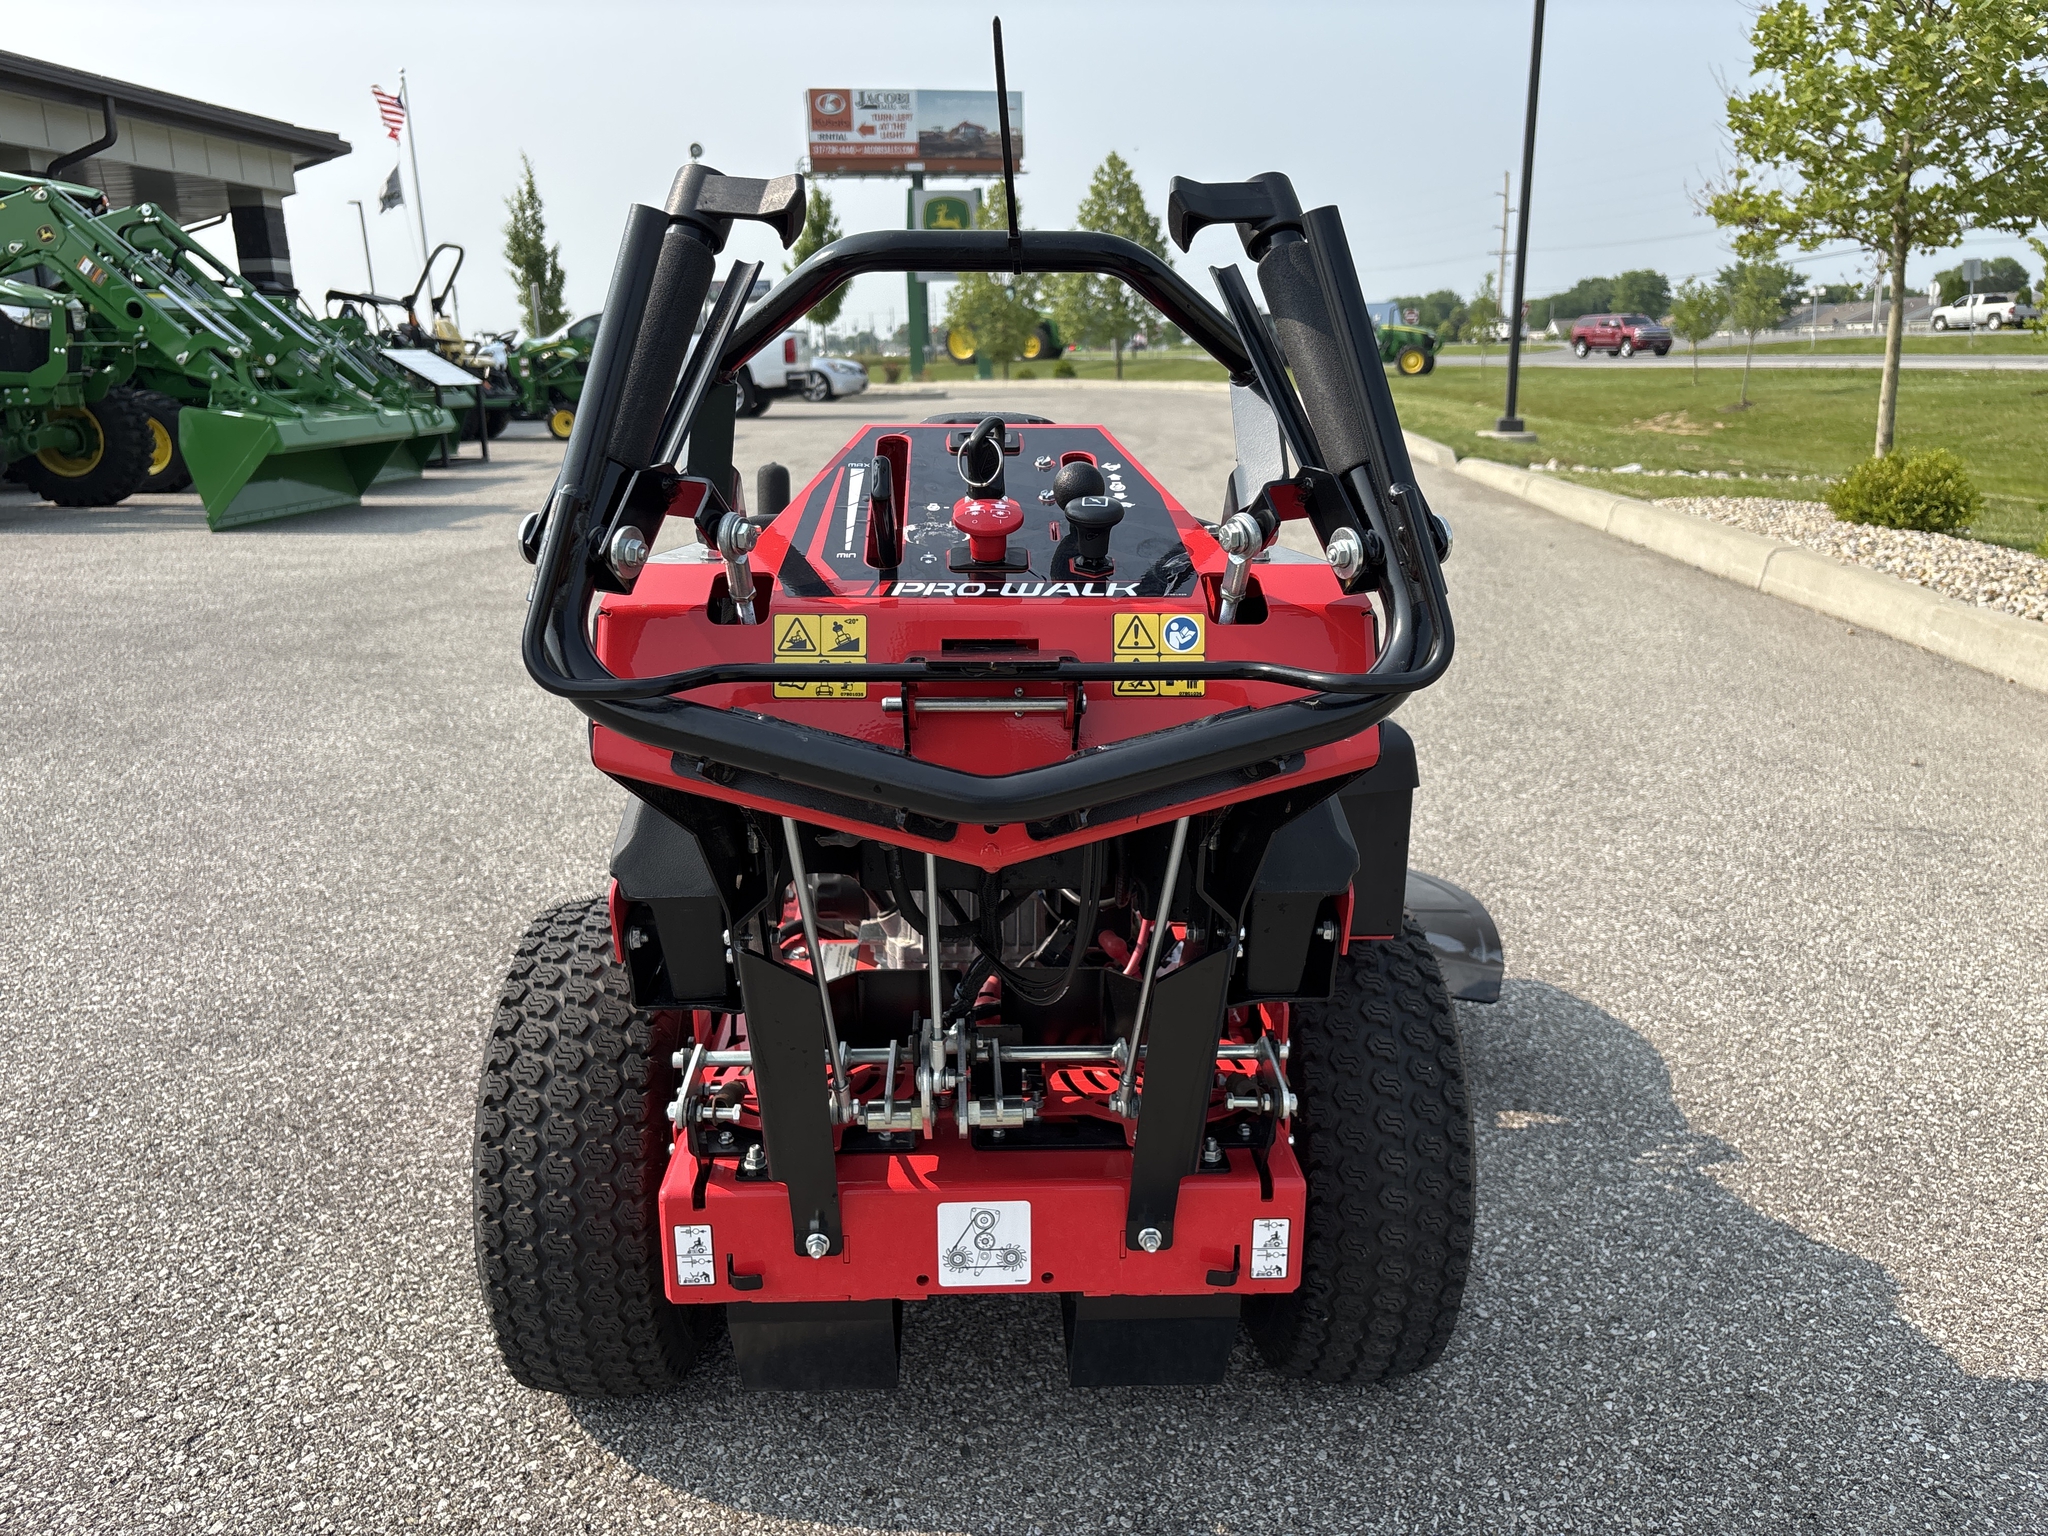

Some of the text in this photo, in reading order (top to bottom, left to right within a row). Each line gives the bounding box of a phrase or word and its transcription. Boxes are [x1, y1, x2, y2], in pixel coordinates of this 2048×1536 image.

[871, 113, 913, 122] TURN LEFT
[879, 122, 907, 130] AT THE
[817, 133, 848, 141] RENTAL
[880, 131, 905, 139] LIGHT
[890, 582, 1142, 597] PRO-WALK
